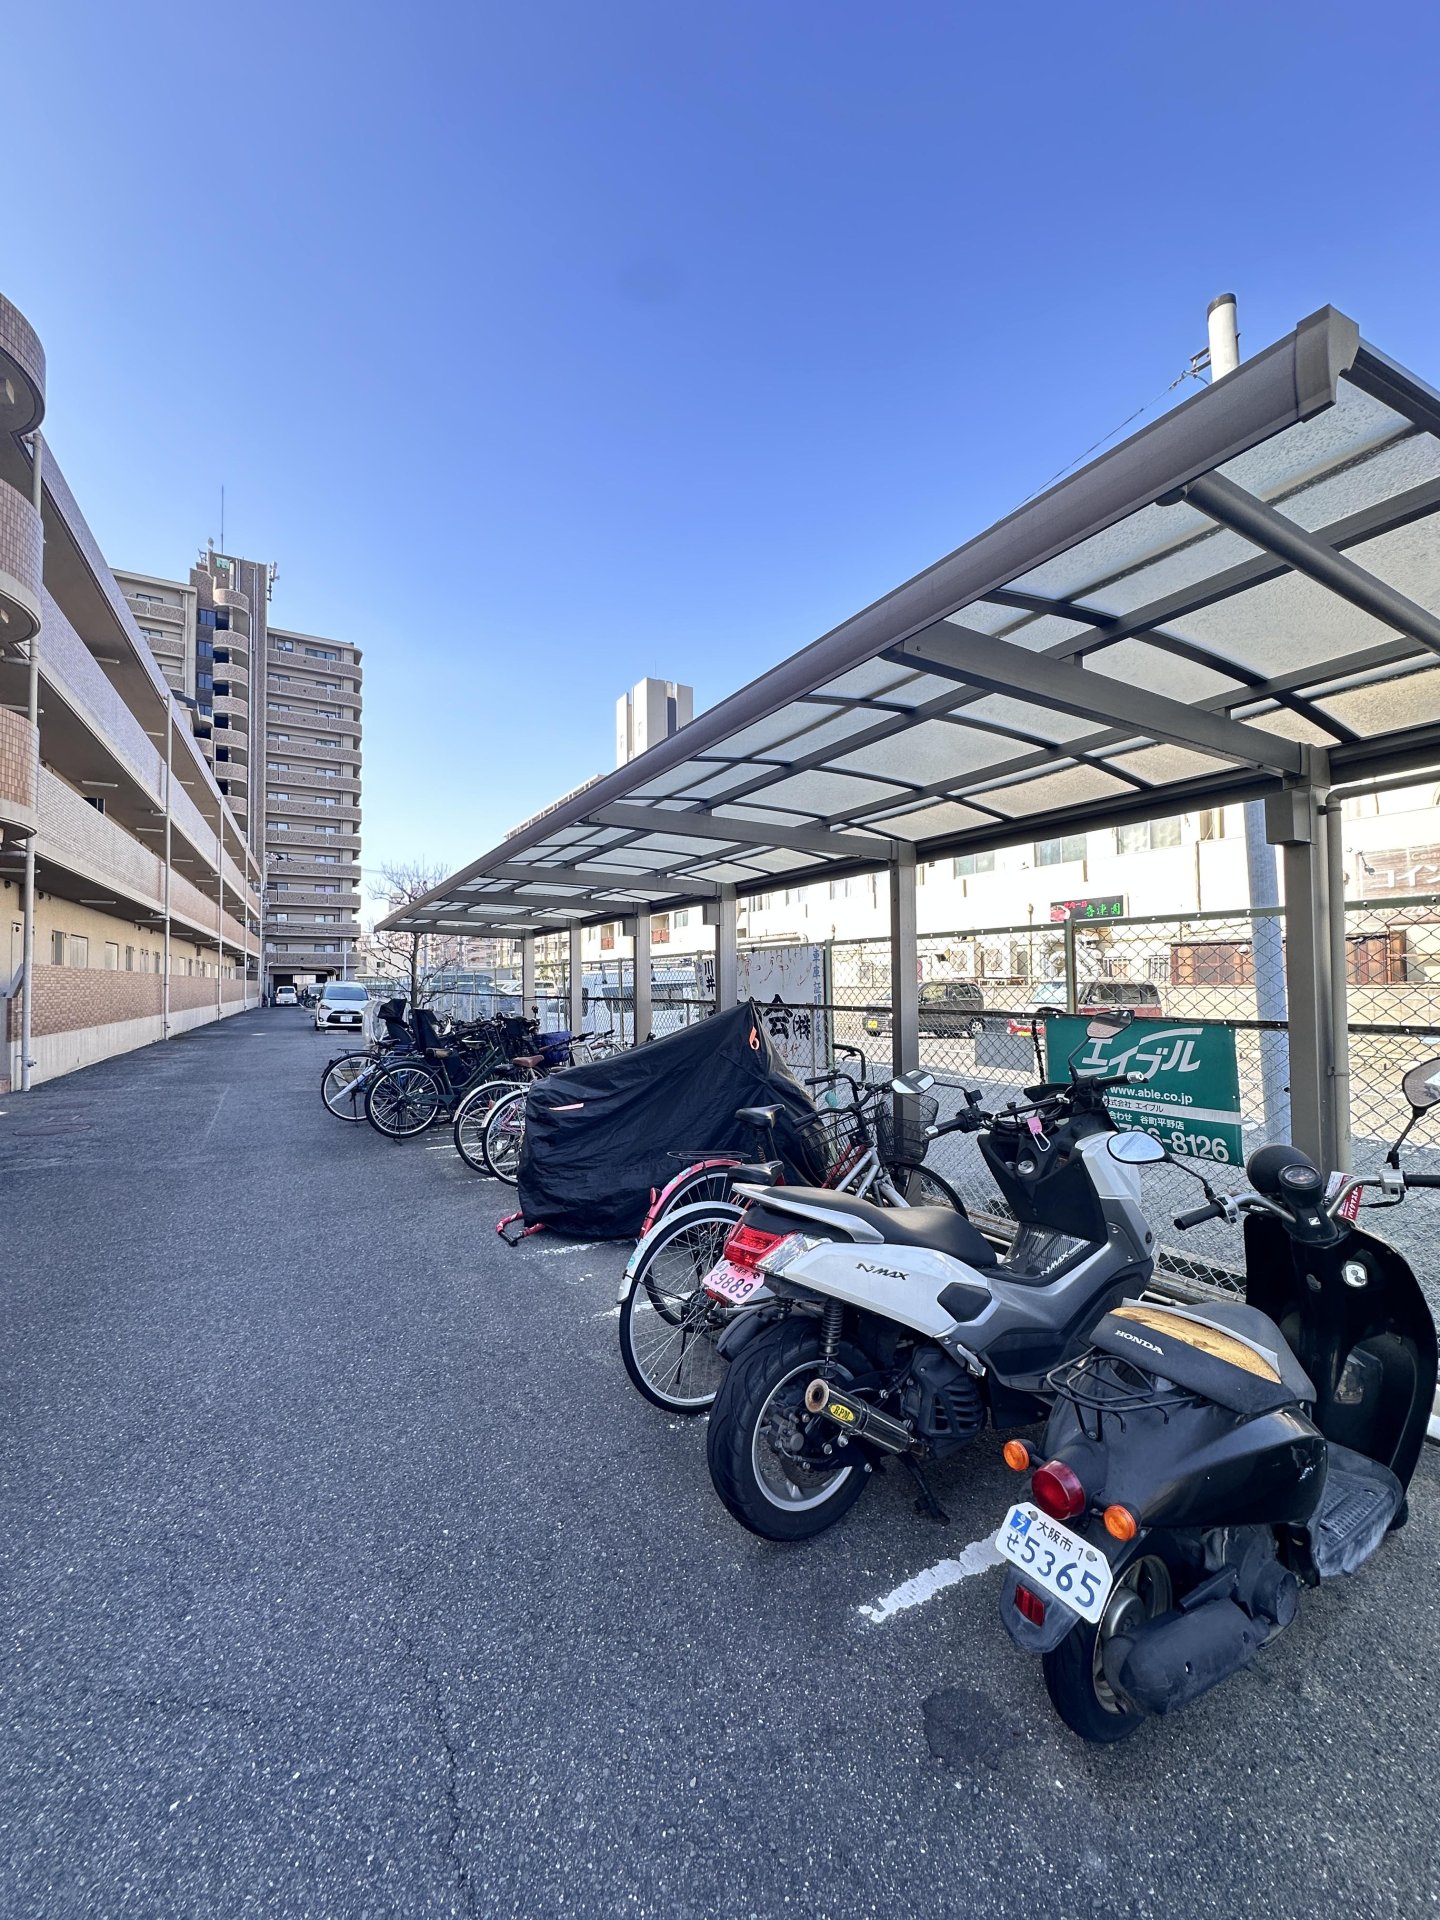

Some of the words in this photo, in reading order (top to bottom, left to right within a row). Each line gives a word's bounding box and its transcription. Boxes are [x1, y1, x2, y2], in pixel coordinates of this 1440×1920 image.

[1069, 1027, 1204, 1080] エイブル
[1110, 1086, 1193, 1105] www.able.co.jp
[1140, 1115, 1185, 1131] 谷町平野店
[714, 1273, 754, 1298] 9889
[1114, 1329, 1164, 1355] HONDA
[833, 1405, 851, 1420] RPM
[1037, 1521, 1073, 1552] 大阪市
[1007, 1533, 1019, 1553] せ
[1020, 1536, 1101, 1608] 5365
